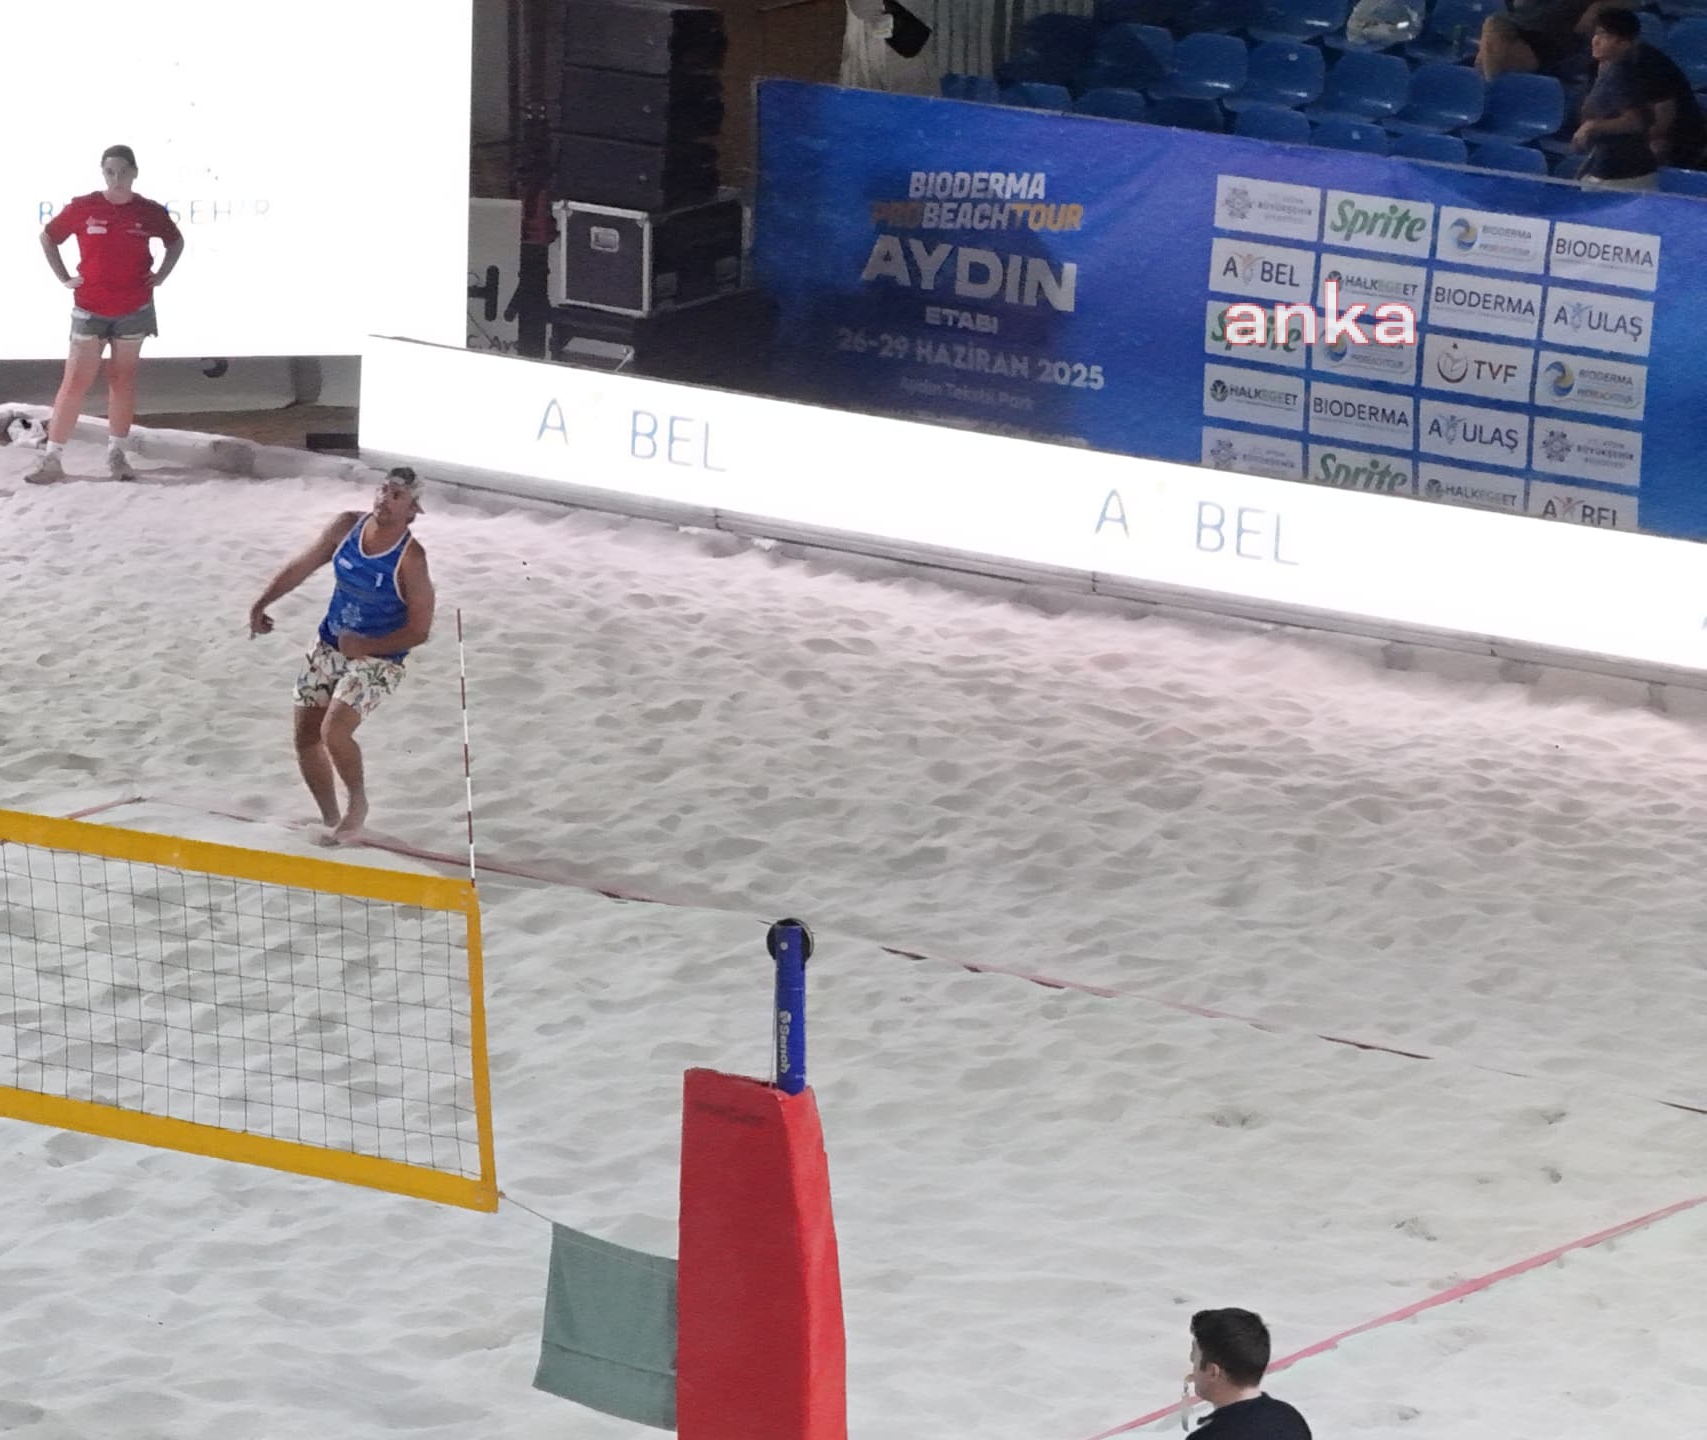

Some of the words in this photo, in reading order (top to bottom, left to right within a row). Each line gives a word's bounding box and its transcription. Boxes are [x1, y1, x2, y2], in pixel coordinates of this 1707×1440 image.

[909, 172, 1045, 200] BIODERMA
[1331, 199, 1427, 242] Sprite
[1555, 238, 1653, 268] BIODERMA
[861, 234, 1077, 313] AYDIN
[1435, 286, 1535, 316] BIODERMA
[925, 306, 998, 334] ETABI
[1037, 359, 1105, 390] 2025
[1474, 360, 1517, 384] TVF
[1313, 397, 1409, 427] BIODERMA
[1315, 453, 1407, 491] Sprite
[780, 1025, 791, 1073] Senoh
